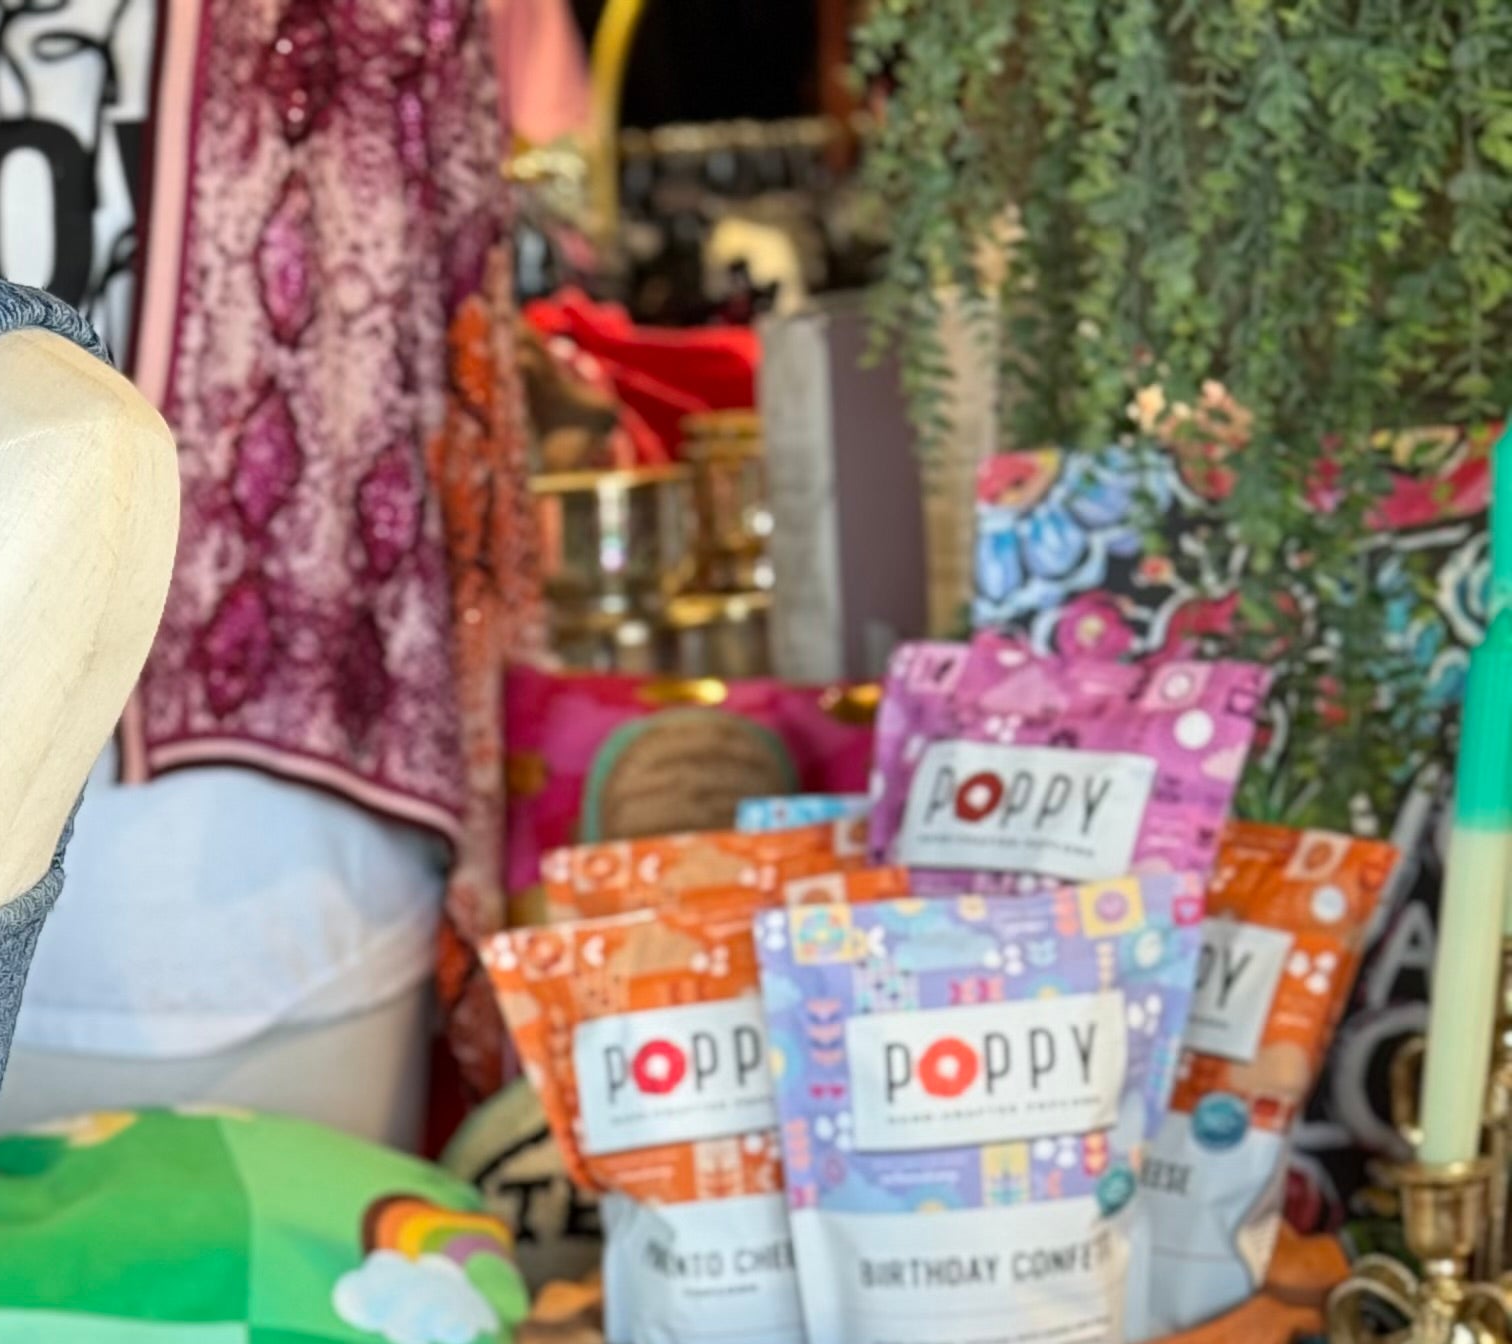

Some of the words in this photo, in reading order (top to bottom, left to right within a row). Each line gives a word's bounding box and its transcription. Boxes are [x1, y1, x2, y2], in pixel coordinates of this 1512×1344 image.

[924, 765, 1112, 835] POPPY
[884, 1023, 1096, 1104] POPPY
[860, 1256, 998, 1288] BIRTHDAY
